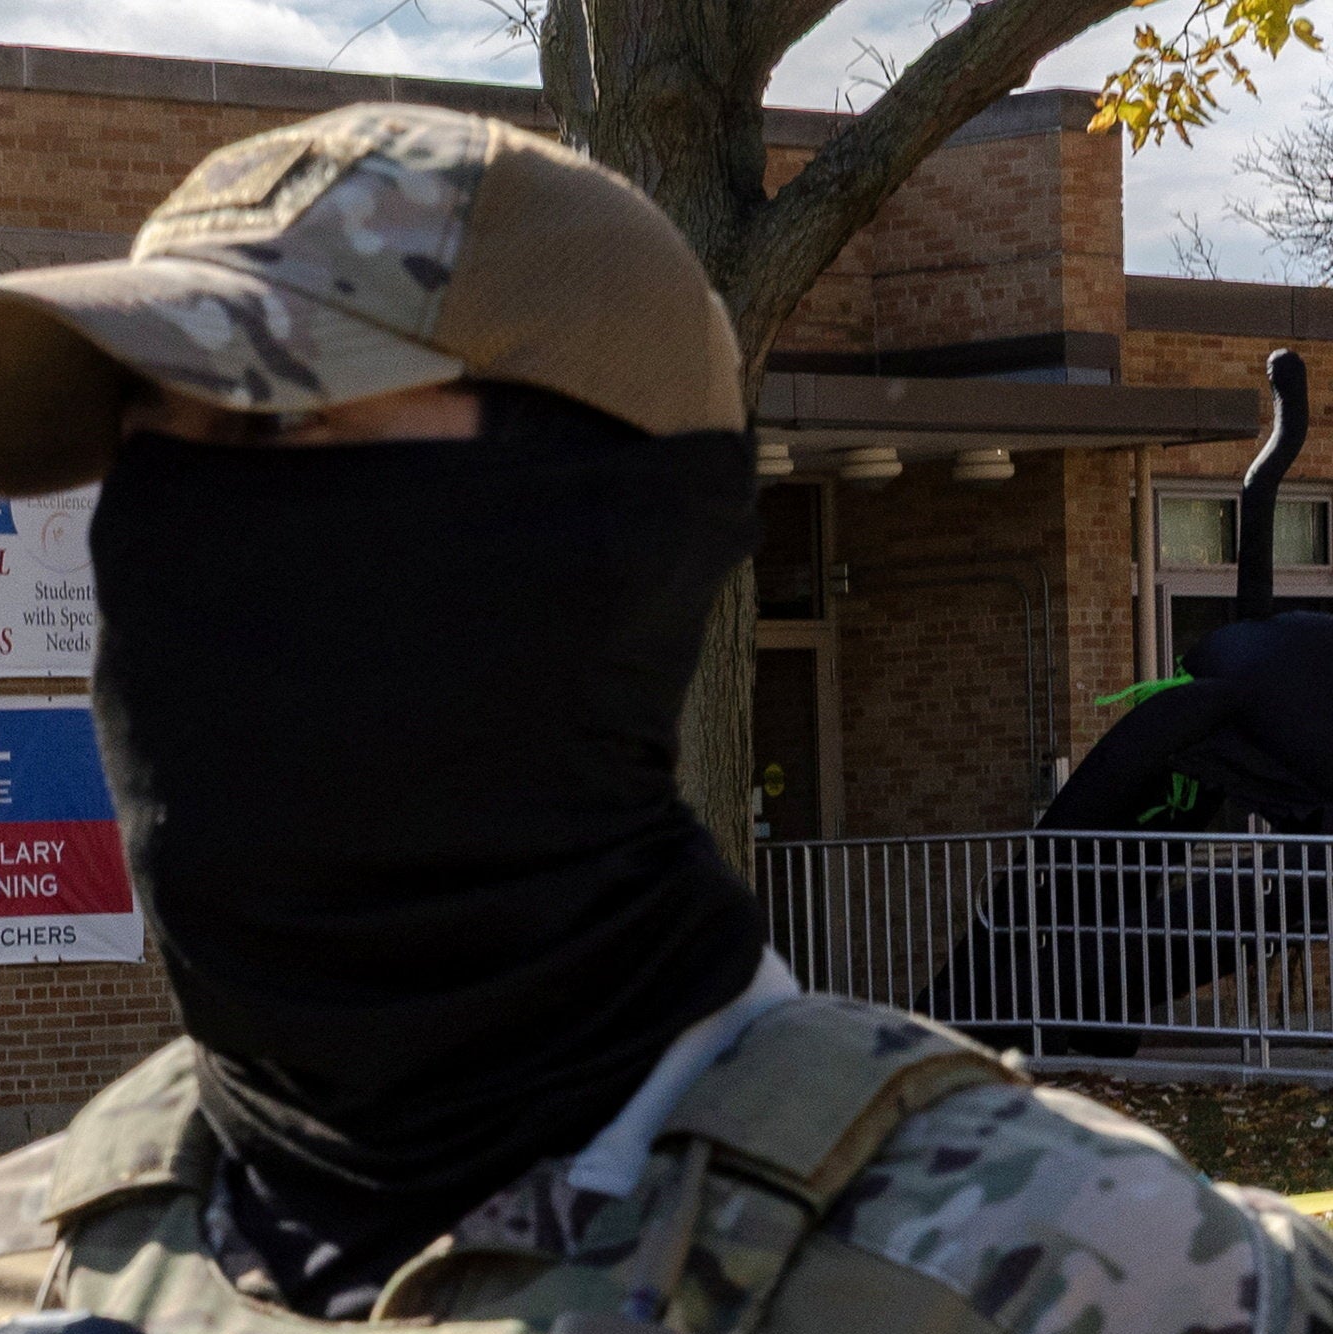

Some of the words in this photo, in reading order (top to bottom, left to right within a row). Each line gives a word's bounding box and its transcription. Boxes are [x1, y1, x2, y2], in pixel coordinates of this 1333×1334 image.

[23, 605, 56, 626] with
[61, 606, 96, 632] Spec
[47, 631, 91, 651] Needs
